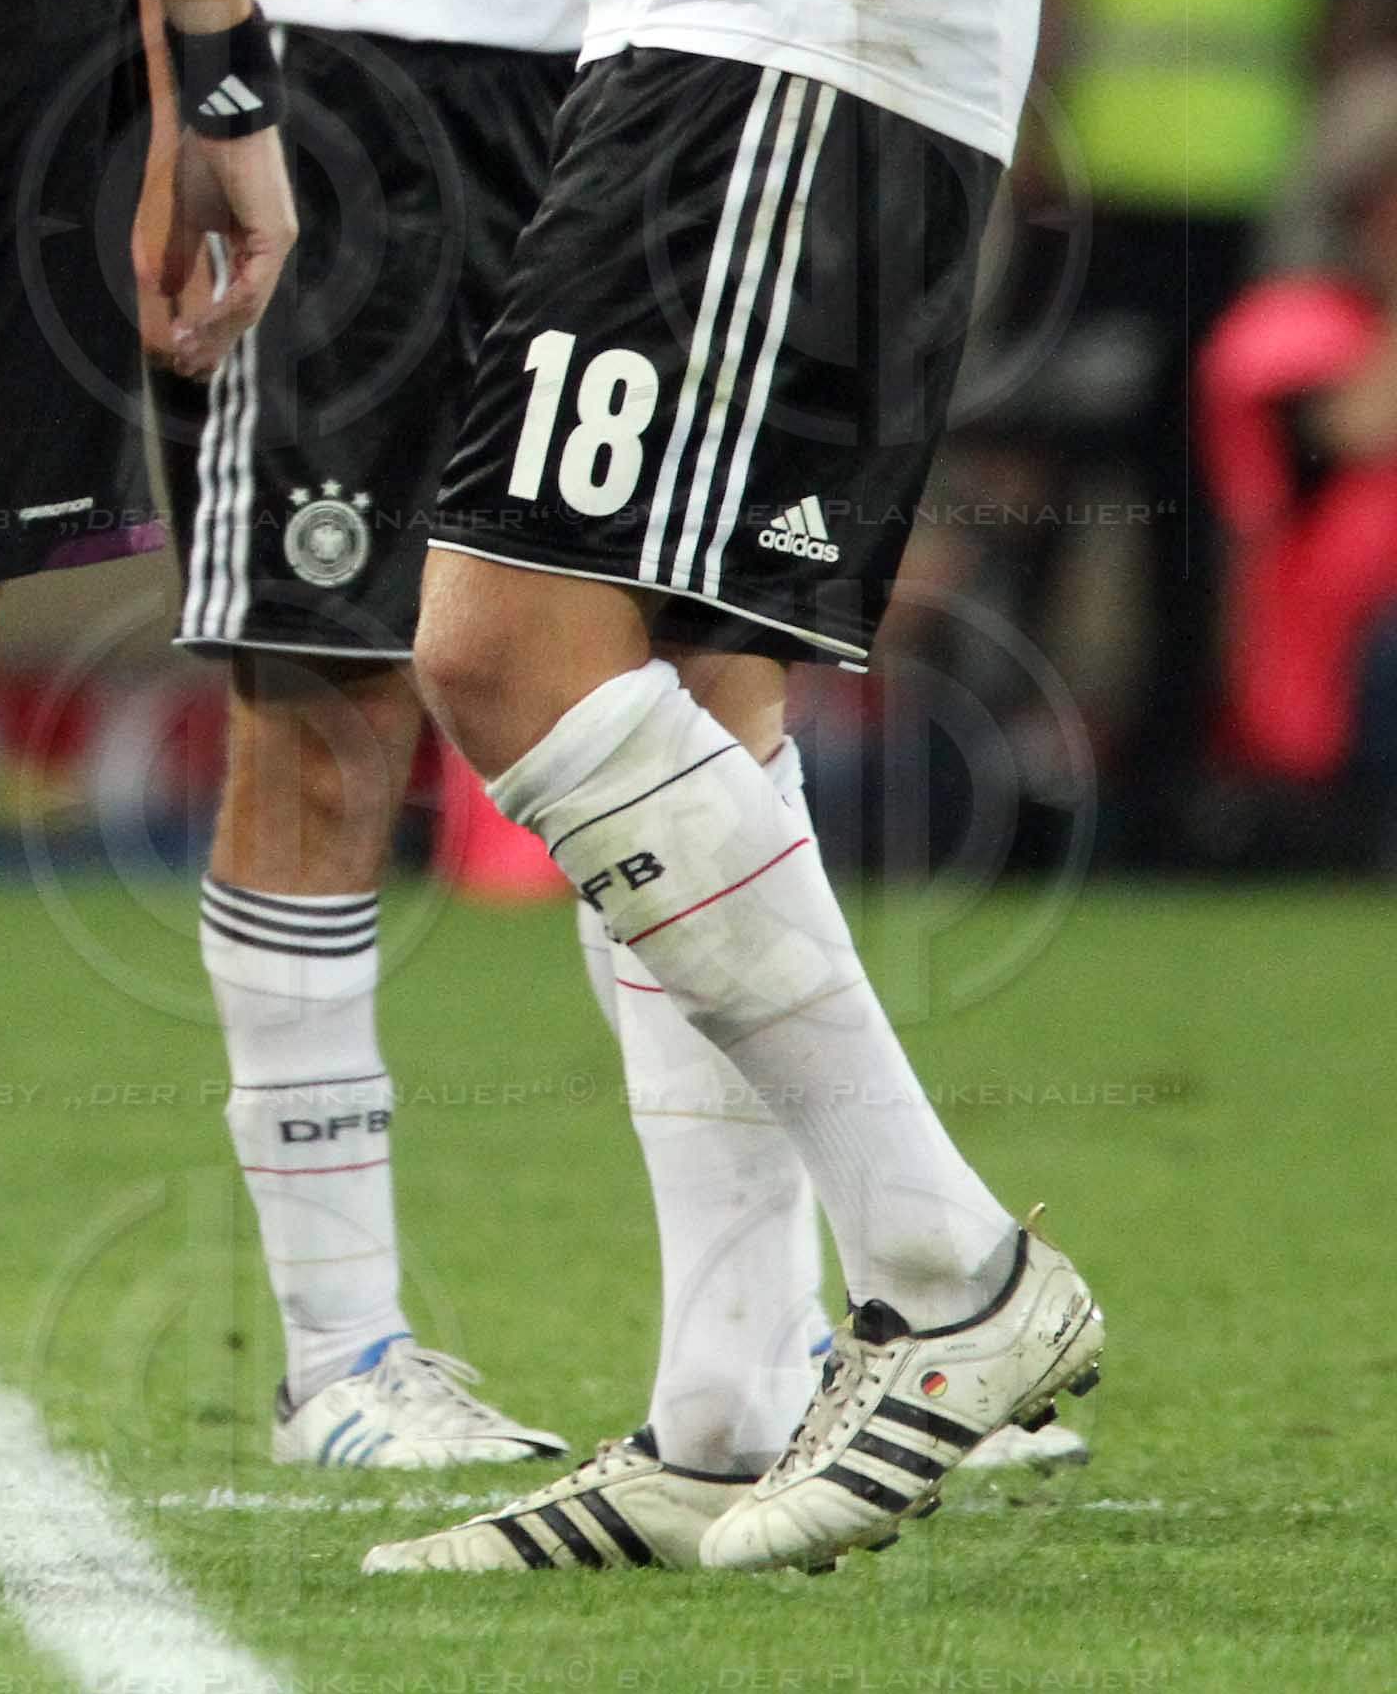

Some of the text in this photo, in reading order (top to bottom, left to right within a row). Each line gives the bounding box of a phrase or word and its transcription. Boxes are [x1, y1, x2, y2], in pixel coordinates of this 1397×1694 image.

[508, 329, 660, 517] 18
[757, 528, 840, 563] adidas
[581, 851, 666, 913] FB
[279, 1109, 391, 1144] DFB
